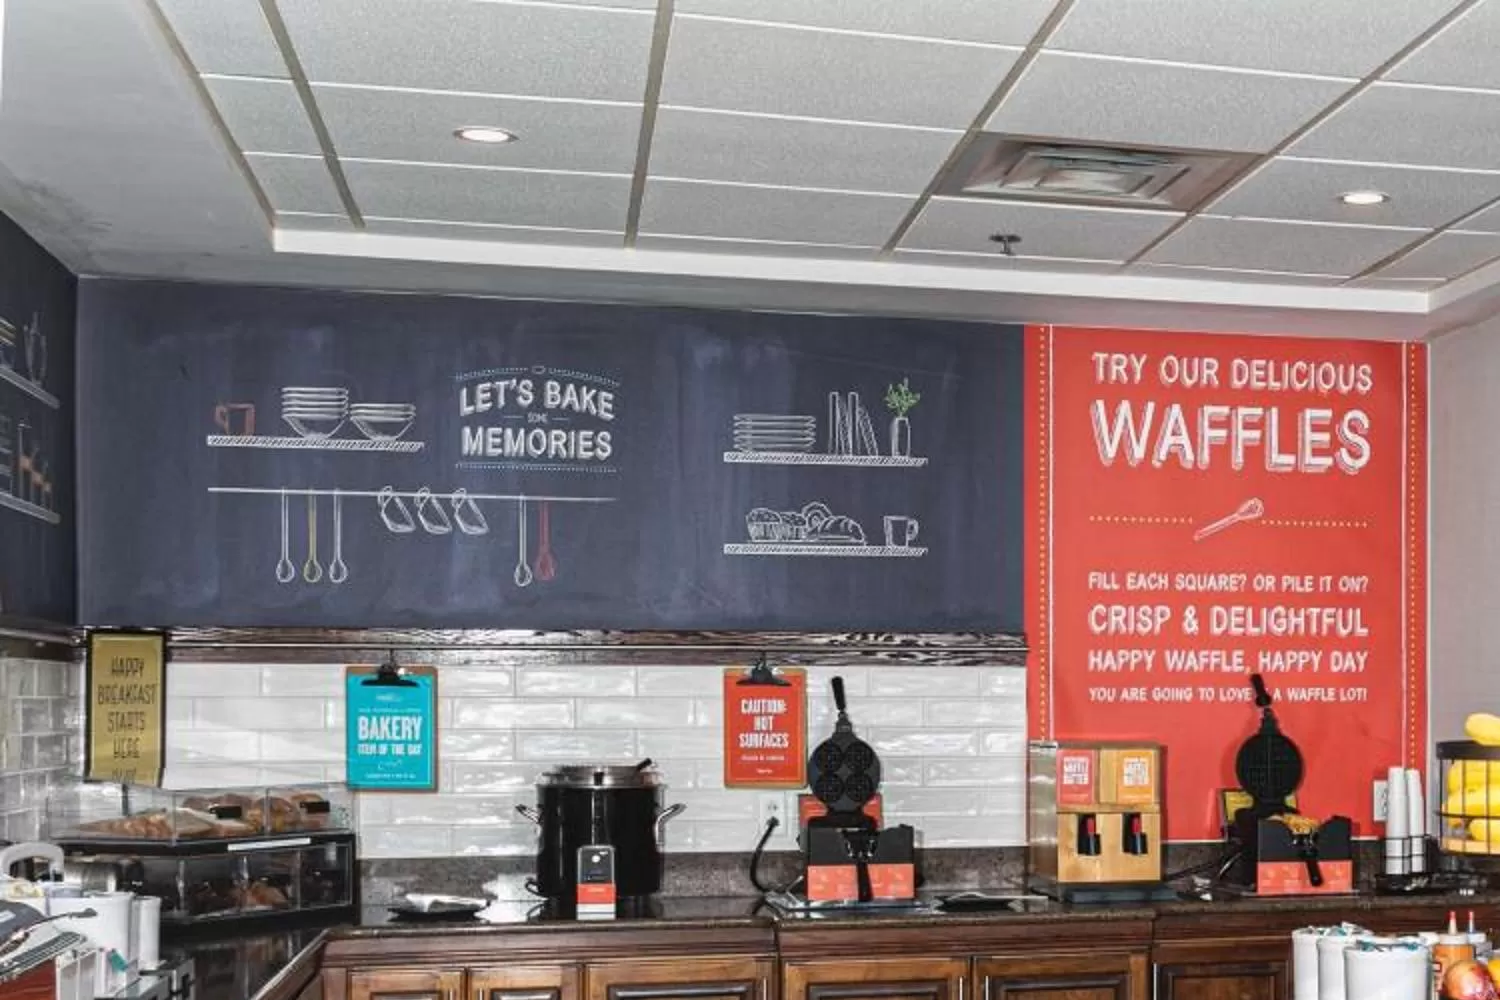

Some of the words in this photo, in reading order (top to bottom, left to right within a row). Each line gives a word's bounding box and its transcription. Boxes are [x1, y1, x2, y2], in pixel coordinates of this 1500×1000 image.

[1091, 352, 1147, 385] TRY
[1159, 355, 1220, 388] OUR
[1230, 357, 1374, 394] DELICIOUS
[459, 378, 535, 416] LET'S
[544, 380, 616, 421] BAKE
[527, 412, 549, 423] SOME
[461, 426, 613, 461] MEMORIES
[1090, 399, 1372, 476] WAFFLES
[1088, 572, 1120, 591] FILL
[1126, 572, 1169, 591] EACH
[1174, 573, 1247, 592] SQUARE?
[1253, 574, 1277, 592] OR
[1282, 575, 1314, 592] PILE
[1319, 576, 1332, 592] IT
[1338, 575, 1369, 593] ON?
[1088, 605, 1171, 635] CRISP
[1183, 605, 1199, 635] &
[1209, 606, 1369, 637] DELIGHTFUL
[111, 656, 145, 678] HAPPY
[1088, 649, 1156, 672] HAPPY
[1165, 650, 1250, 675] WAFFLE,
[1258, 650, 1323, 673] HAPPY
[1330, 651, 1369, 673] DAY
[97, 683, 157, 705] BREAKFAST
[1088, 687, 1116, 702] YOU
[1121, 687, 1148, 702] ARE
[1152, 687, 1193, 702] GOING
[1199, 687, 1215, 702] TO
[1219, 687, 1252, 702] LOVE
[1272, 687, 1283, 702] A
[1287, 688, 1336, 702] WAFFLE
[1339, 688, 1368, 702] LOT!
[107, 711, 146, 733] STARTS
[357, 715, 423, 741] BAKERY
[754, 715, 774, 731] HOT
[113, 737, 141, 759] HERE
[738, 732, 790, 748] SURFACES
